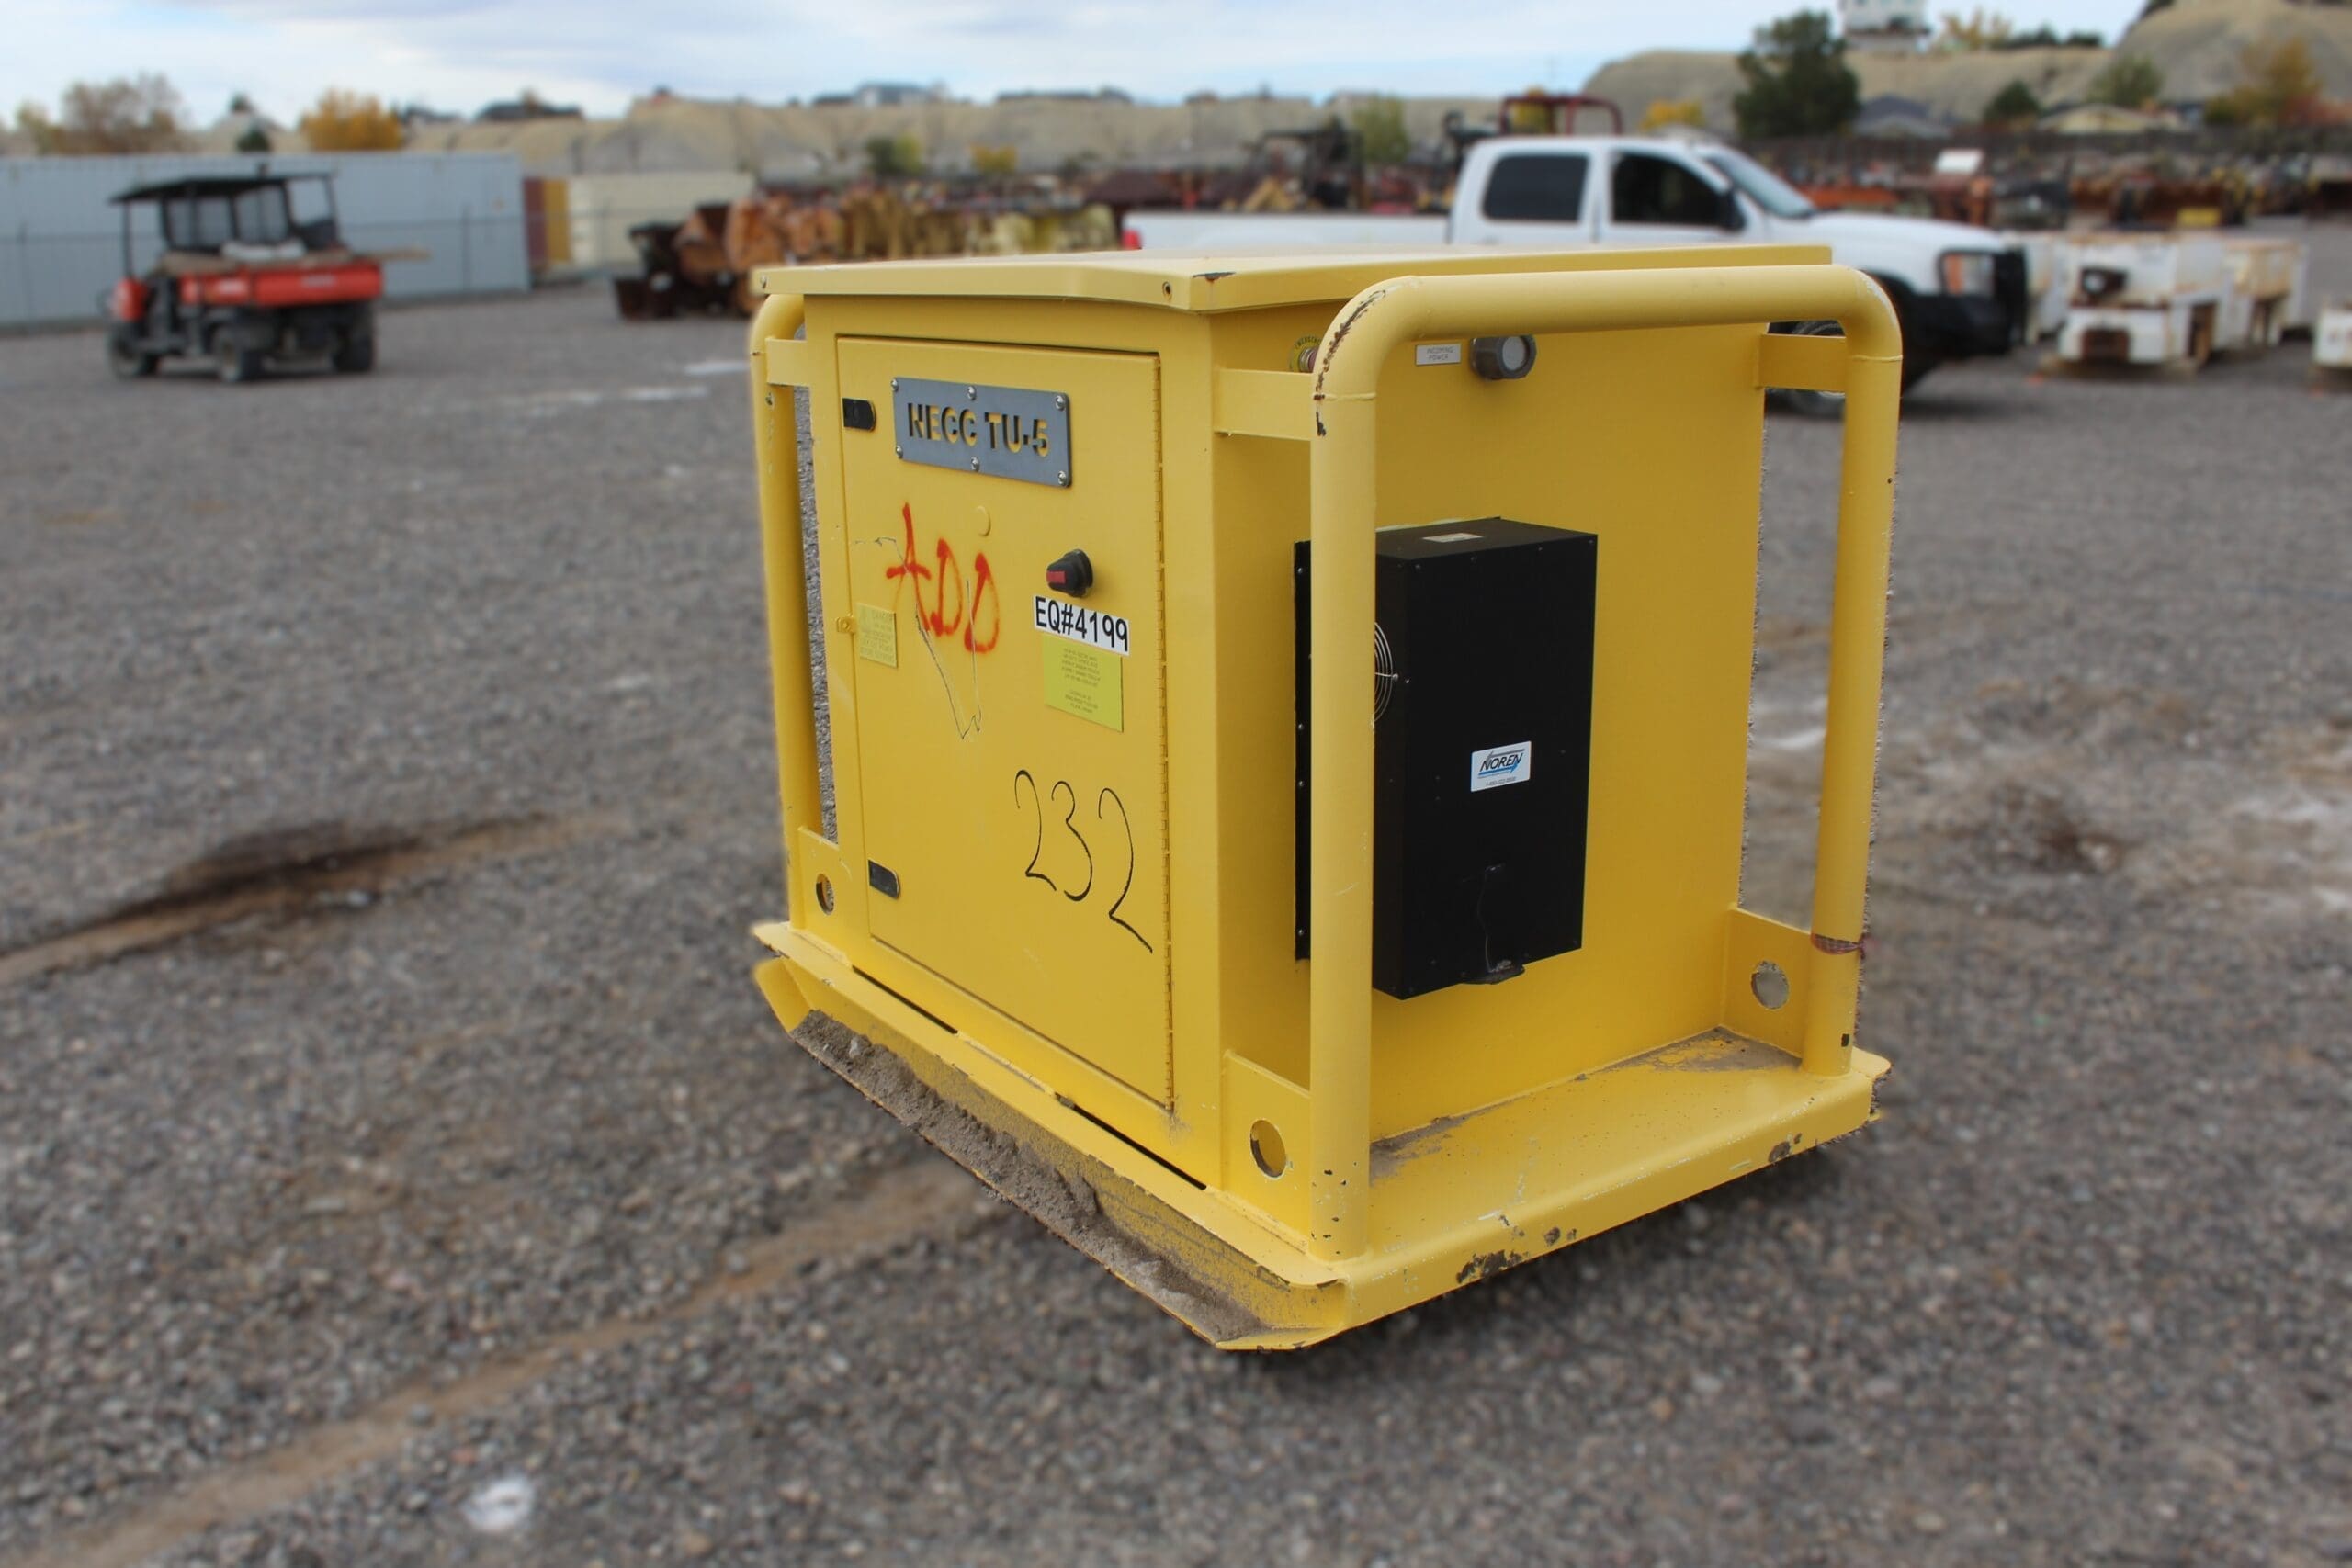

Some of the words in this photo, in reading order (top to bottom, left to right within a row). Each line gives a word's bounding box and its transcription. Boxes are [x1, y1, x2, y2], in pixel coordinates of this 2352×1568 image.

[984, 412, 1049, 457] TU-5
[1035, 595, 1128, 652] EQ#4199
[1480, 751, 1524, 773] NOREN
[1014, 769, 1153, 954] 232
